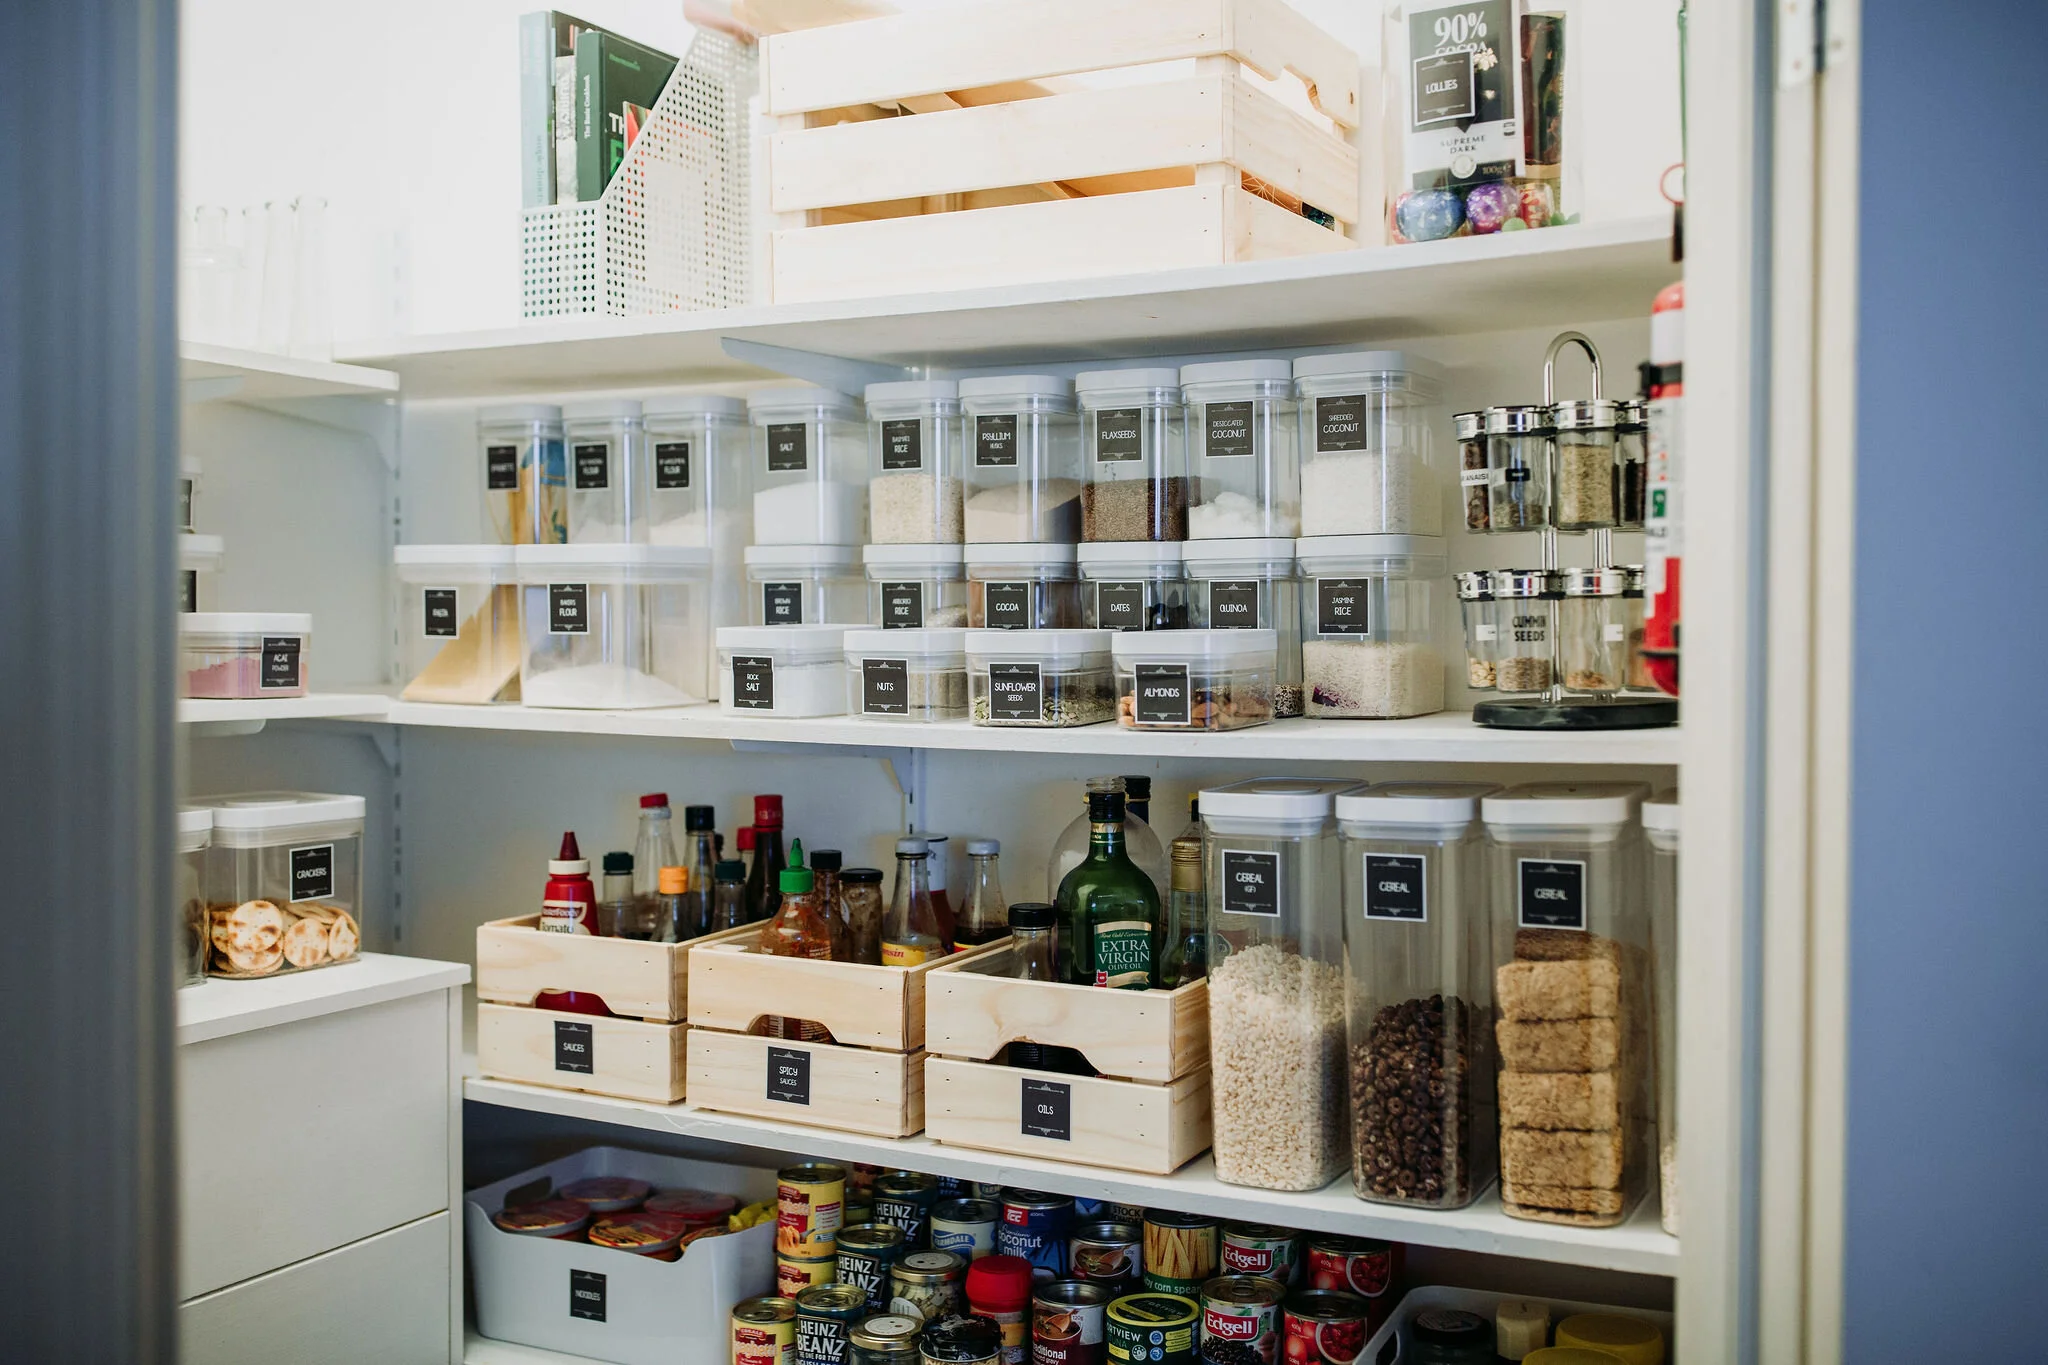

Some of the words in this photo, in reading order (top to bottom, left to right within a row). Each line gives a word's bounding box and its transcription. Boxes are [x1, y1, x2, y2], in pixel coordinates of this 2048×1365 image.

[1434, 10, 1488, 48] 90%
[1425, 79, 1458, 95] LOLLIES
[1450, 145, 1477, 154] DARK
[1328, 414, 1354, 422] SHREDDED
[1323, 422, 1359, 434] COCONUT
[982, 432, 1011, 442] PSYLLIUM
[1101, 430, 1137, 440] FLAXSEEDS
[1211, 429, 1247, 440] COCONUT
[779, 442, 794, 453] SALT
[893, 443, 909, 454] RICE
[1331, 596, 1355, 605] JASMINE
[558, 607, 578, 617] FLOUR
[775, 606, 790, 615] RICE
[894, 606, 910, 616] RICE
[995, 602, 1020, 612] COCOA
[1110, 603, 1131, 613] DATES
[1219, 603, 1248, 613] QUINOA
[1334, 606, 1352, 616] RICE
[1514, 630, 1546, 642] SEEDS
[746, 673, 760, 681] ROCK
[745, 682, 760, 692] SALT
[876, 682, 894, 692] NUTS
[994, 682, 1036, 692] SUNFLOWER
[1143, 686, 1180, 698] ALMONDS
[1007, 694, 1024, 702] SEEDS
[296, 867, 327, 879] CRACKERS
[1235, 872, 1264, 884] CEREAL
[1378, 881, 1410, 893] CEREAL
[1534, 887, 1568, 900] CEREAL
[1101, 939, 1149, 952] EXTRA
[1098, 950, 1150, 965] VIRGIN
[1107, 963, 1128, 971] OLIVE
[1129, 962, 1142, 970] OIL
[563, 1042, 585, 1053] SAUCES
[778, 1065, 798, 1077] SPICY
[779, 1077, 797, 1087] SAUCES
[1037, 1104, 1054, 1115] OILS
[876, 1202, 912, 1219] HEINZ
[1003, 1246, 1028, 1260] milk
[1224, 1246, 1266, 1267] Edgell
[838, 1255, 872, 1274] HEINZ
[1154, 1281, 1171, 1293] corn
[800, 1319, 839, 1338] HEINZ
[1206, 1313, 1253, 1336] Edgell
[796, 1333, 846, 1357] BEANZ
[815, 1353, 827, 1361] FOR
[827, 1355, 840, 1363] TWO
